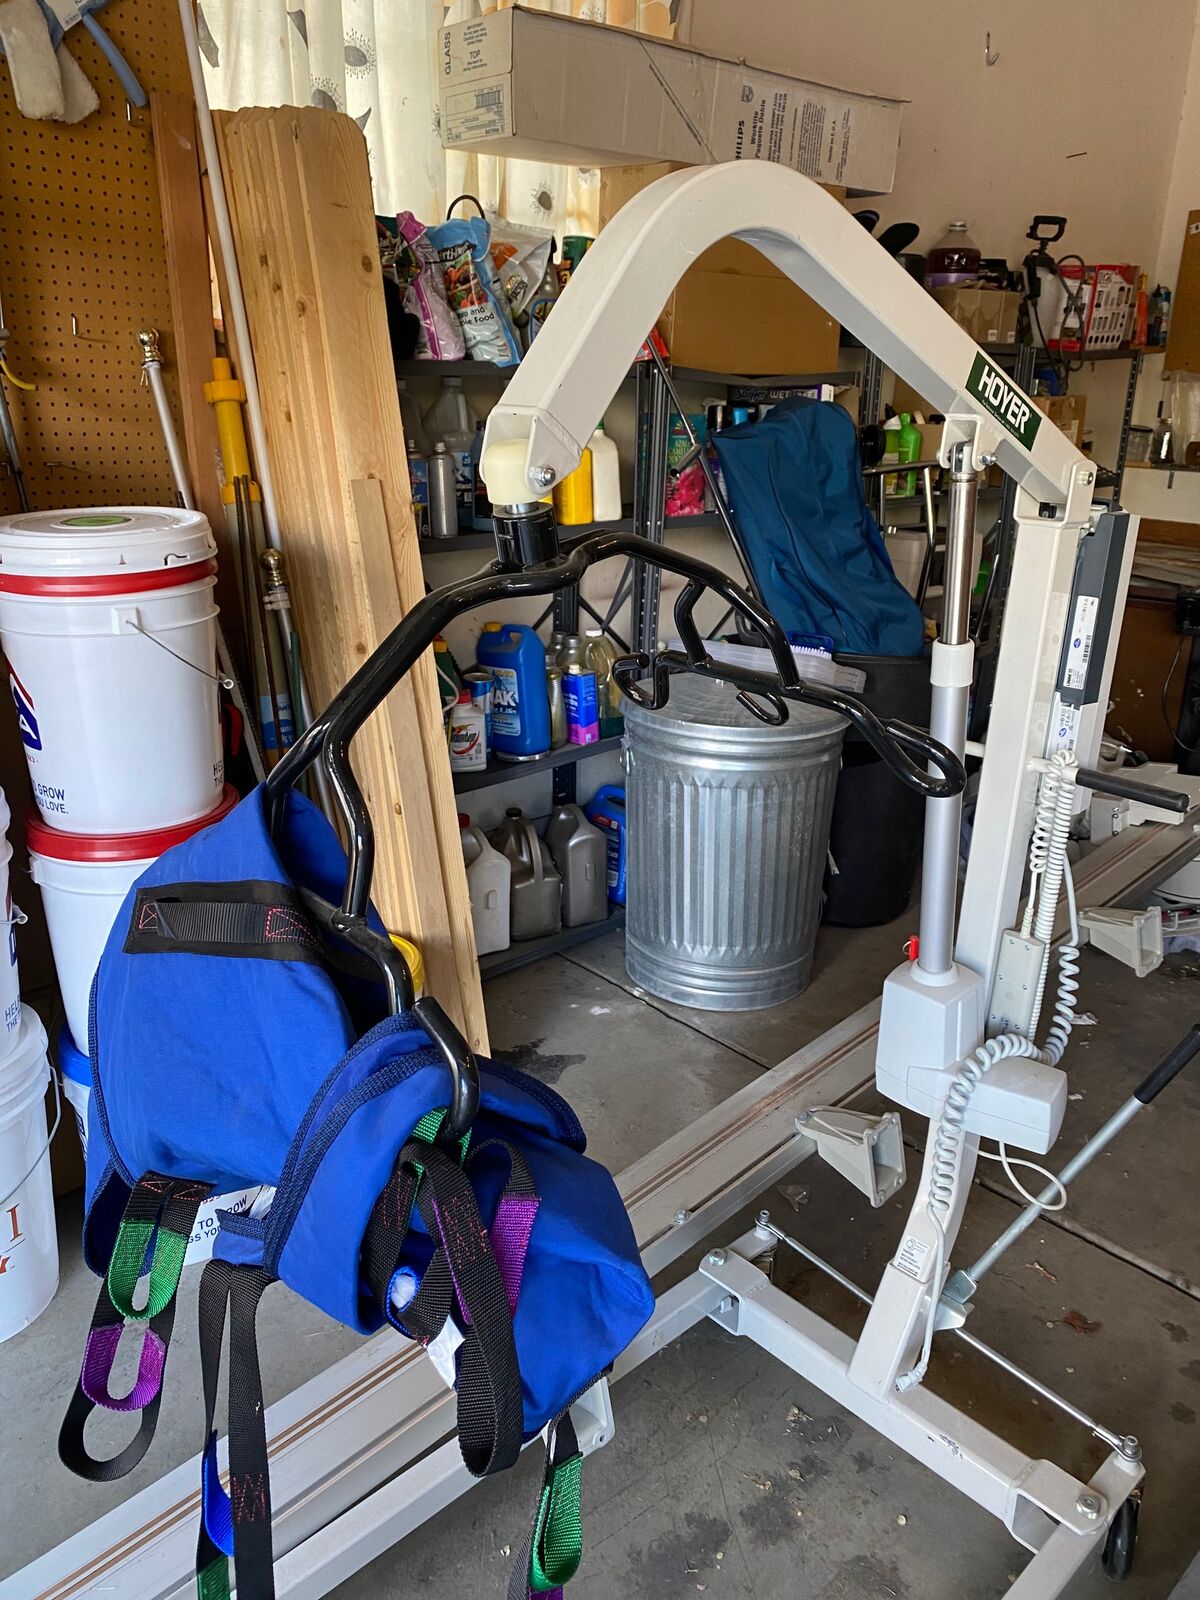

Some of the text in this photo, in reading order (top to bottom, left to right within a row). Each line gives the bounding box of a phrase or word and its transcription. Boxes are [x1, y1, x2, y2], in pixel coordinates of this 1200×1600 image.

[444, 31, 452, 75] GLASS
[469, 50, 481, 60] TOP
[735, 119, 745, 160] HILIPS
[474, 311, 496, 327] Food
[978, 364, 1031, 435] HOYER
[38, 783, 65, 801] GROW
[44, 799, 70, 814] LOVE.
[197, 1217, 214, 1230] TO
